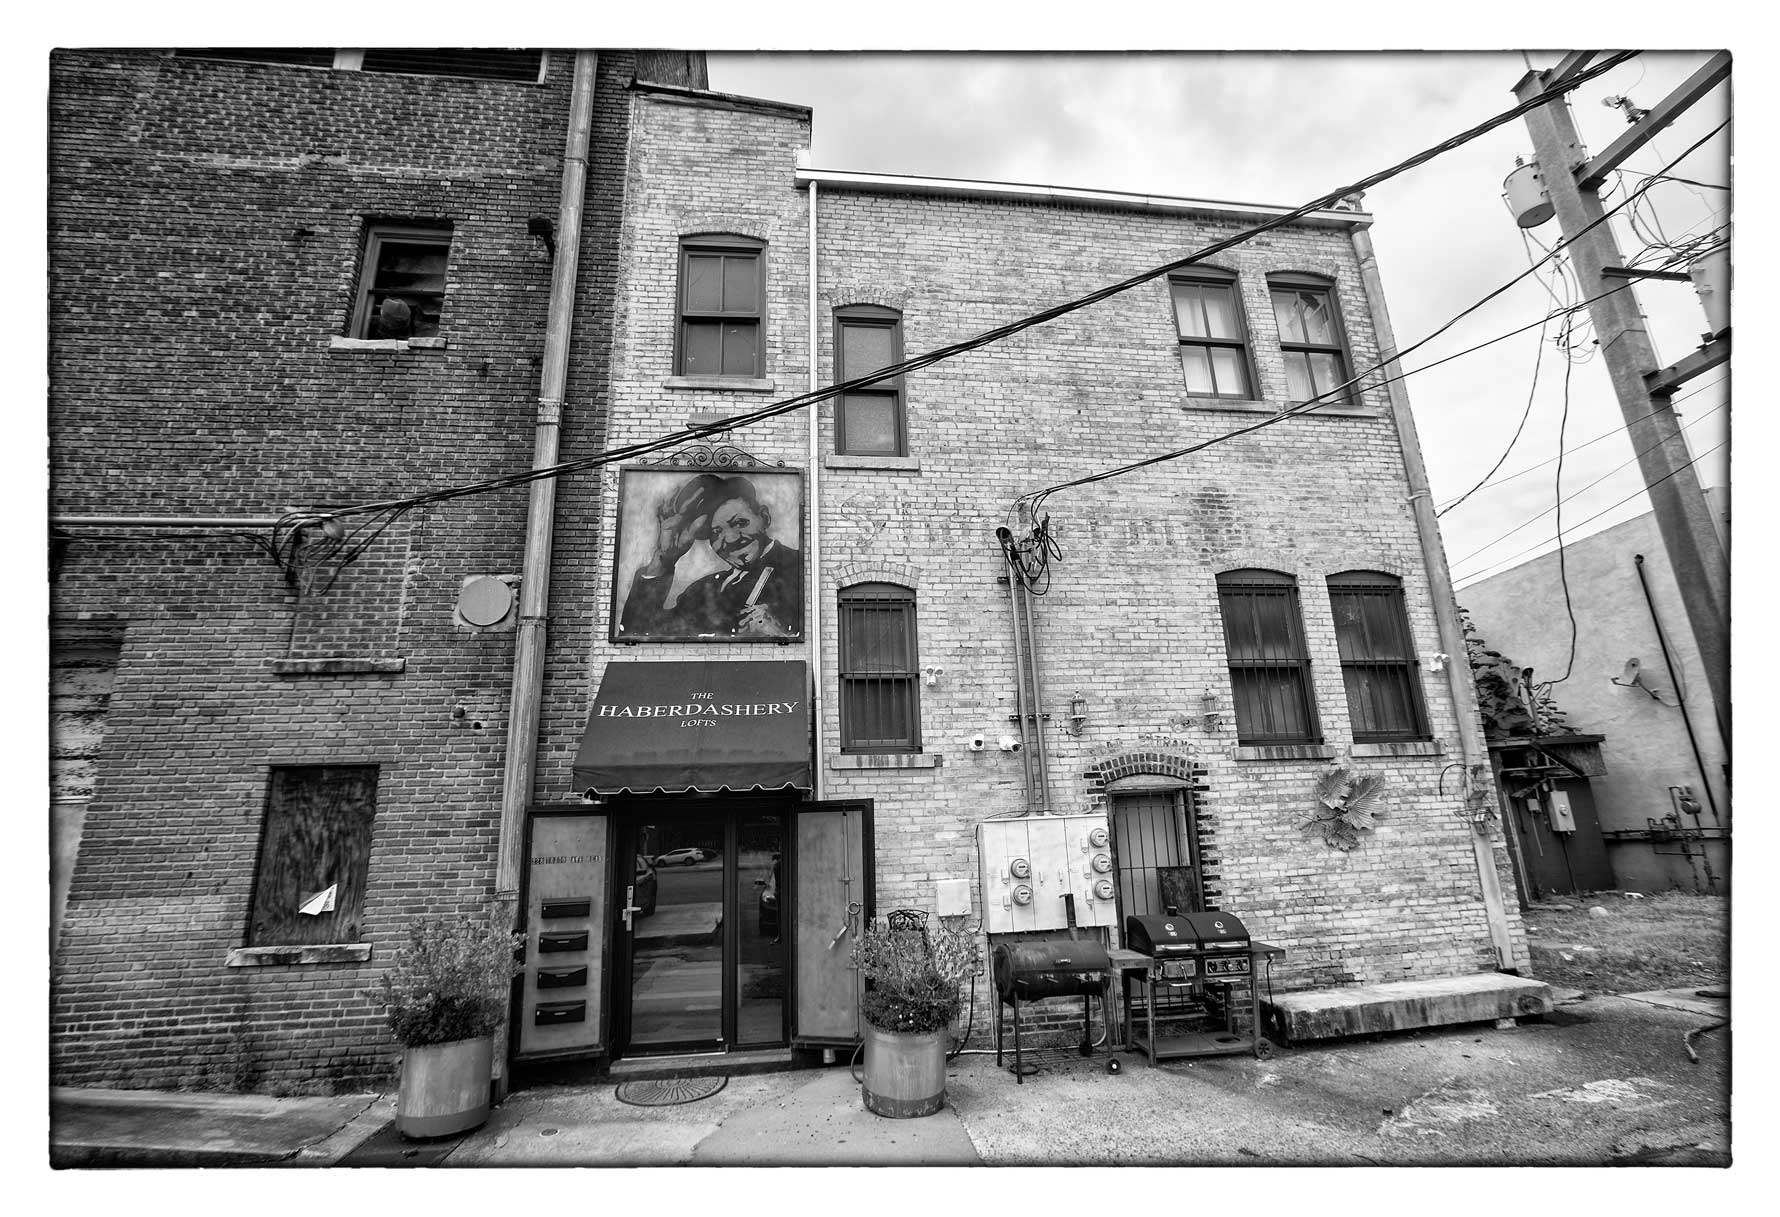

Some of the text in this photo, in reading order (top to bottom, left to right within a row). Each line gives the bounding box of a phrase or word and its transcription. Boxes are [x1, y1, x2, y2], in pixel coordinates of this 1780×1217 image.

[690, 692, 714, 700] THE
[598, 701, 799, 718] HABERDASHERY
[680, 719, 717, 728] LOFTS
